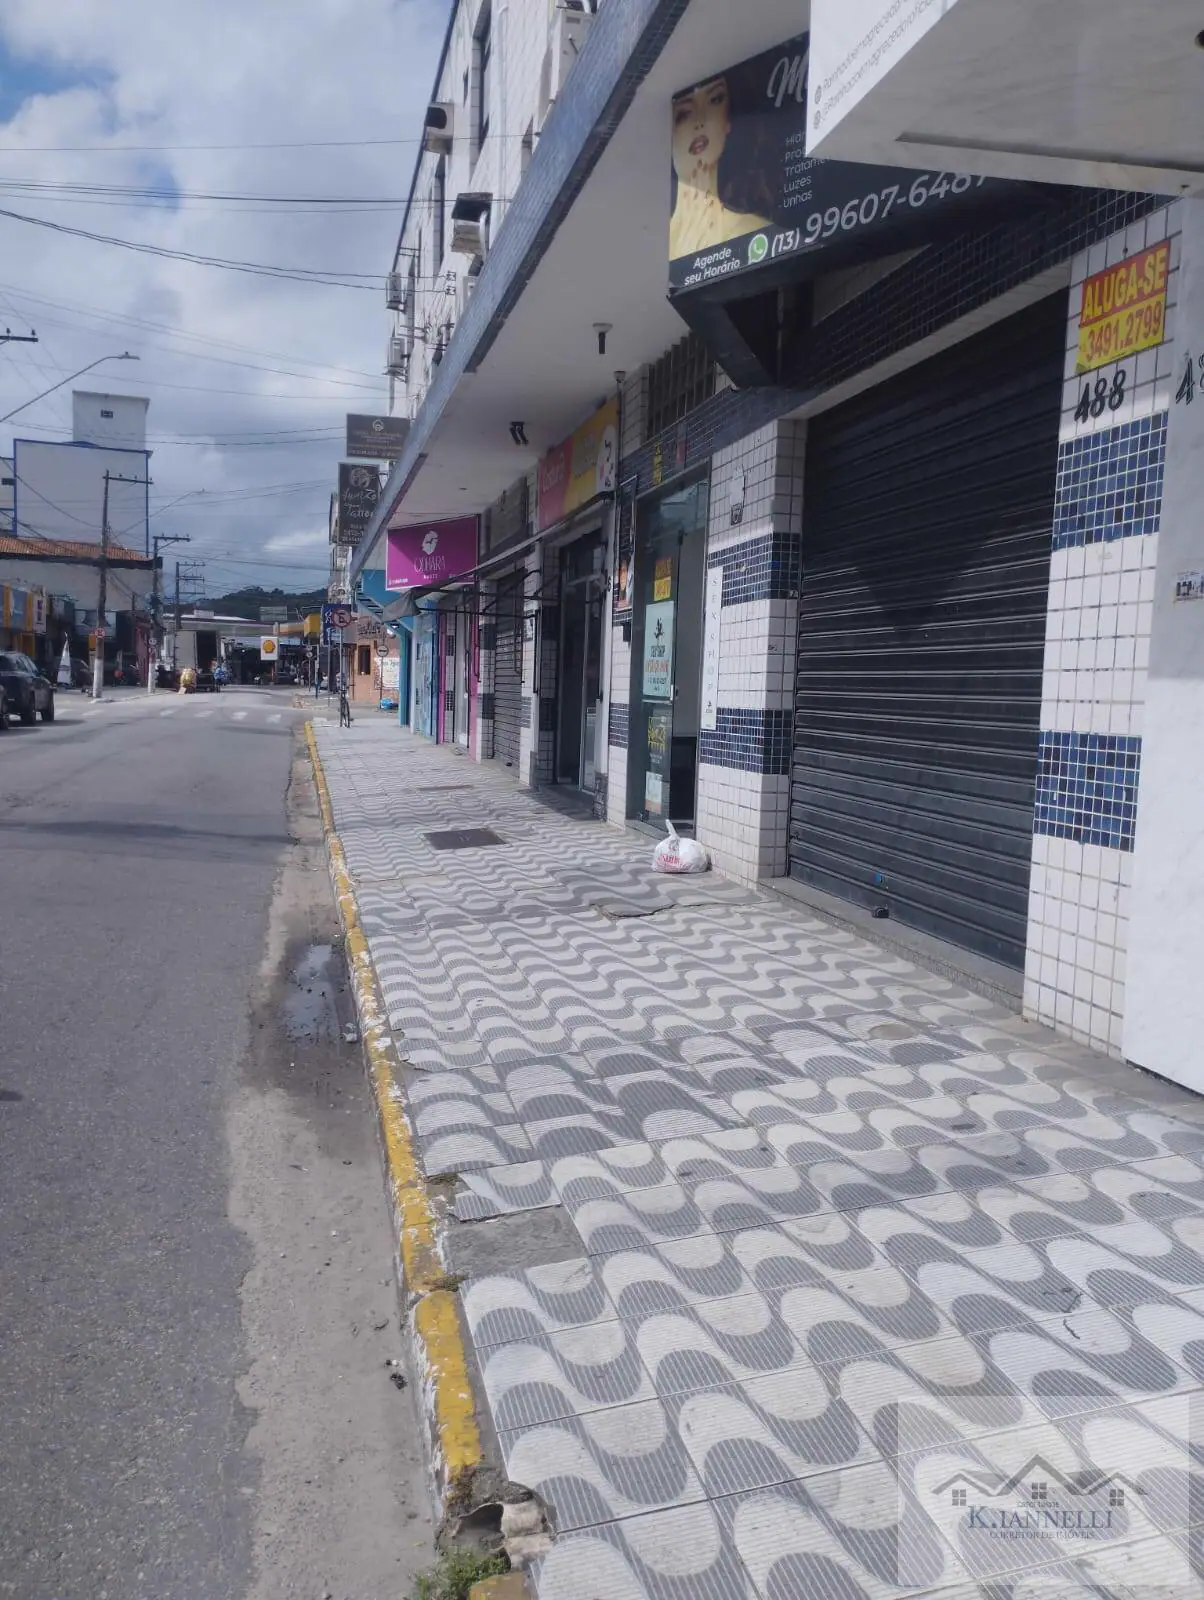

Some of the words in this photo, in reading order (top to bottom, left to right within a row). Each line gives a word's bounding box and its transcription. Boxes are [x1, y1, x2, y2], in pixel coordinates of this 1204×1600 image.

[783, 175, 812, 194] Luzes
[771, 226, 800, 257] (13)
[804, 171, 988, 244] 99607-648
[684, 271, 702, 286] seu
[703, 257, 741, 280] Horário
[692, 247, 732, 270] Agende
[1083, 247, 1168, 323] ALUGA-SE
[1085, 301, 1163, 363] 3491.2799
[1074, 368, 1127, 424] 488
